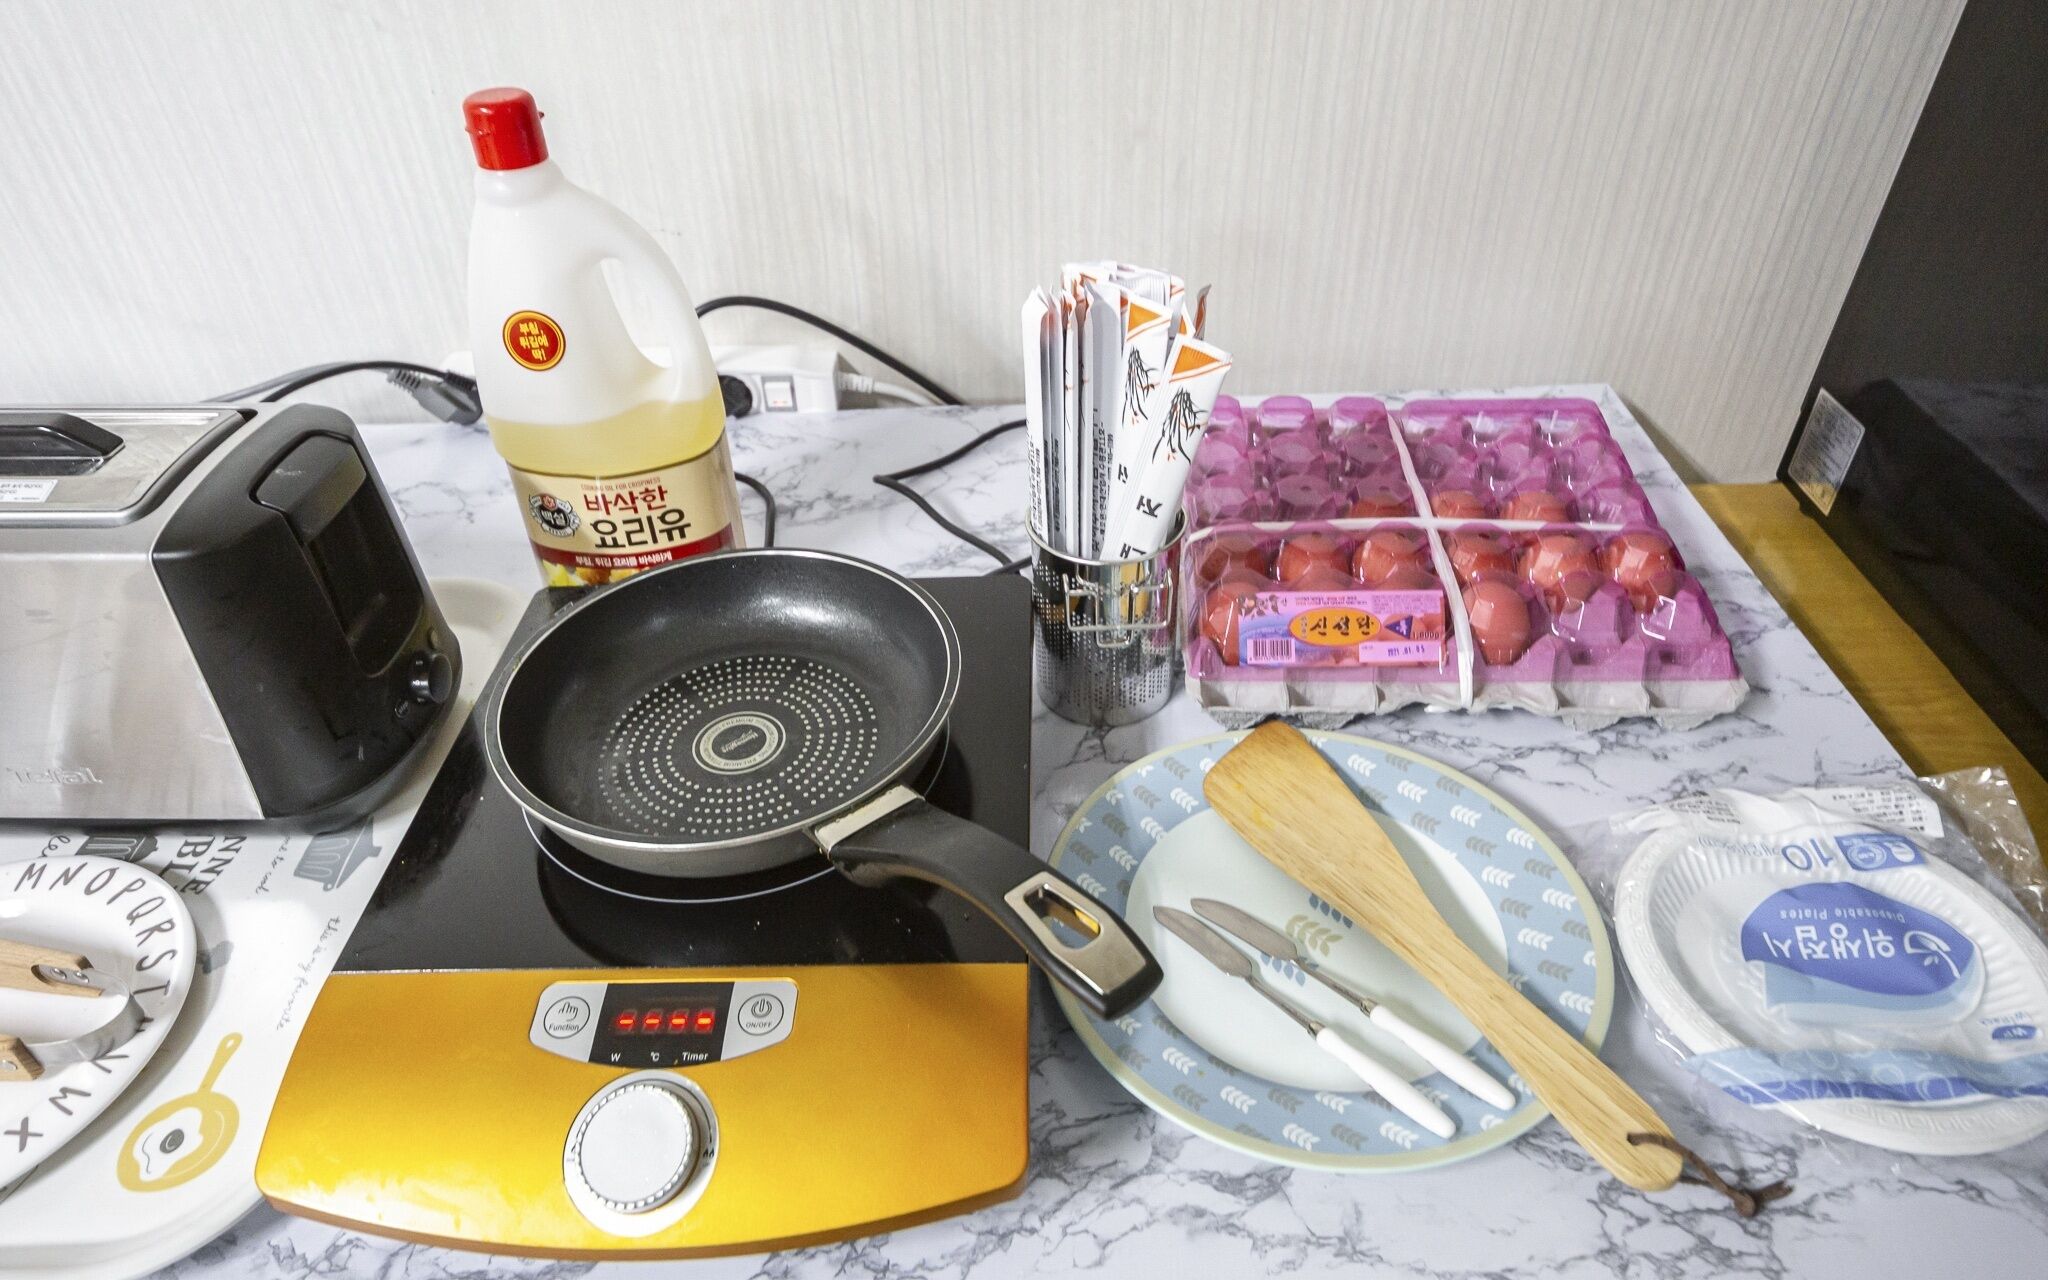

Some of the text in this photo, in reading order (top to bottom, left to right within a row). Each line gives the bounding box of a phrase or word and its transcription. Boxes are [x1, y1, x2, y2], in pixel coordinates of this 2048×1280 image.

[583, 485, 668, 516] 바삭한
[590, 508, 692, 549] 요리유
[1781, 837, 1834, 871] 10
[1834, 908, 1906, 924] Disposable
[1762, 922, 1896, 960] 위생접시
[548, 1023, 580, 1032] Function
[745, 1020, 773, 1029] ON/OFF
[610, 1052, 621, 1062] W
[682, 1051, 709, 1062] Timer
